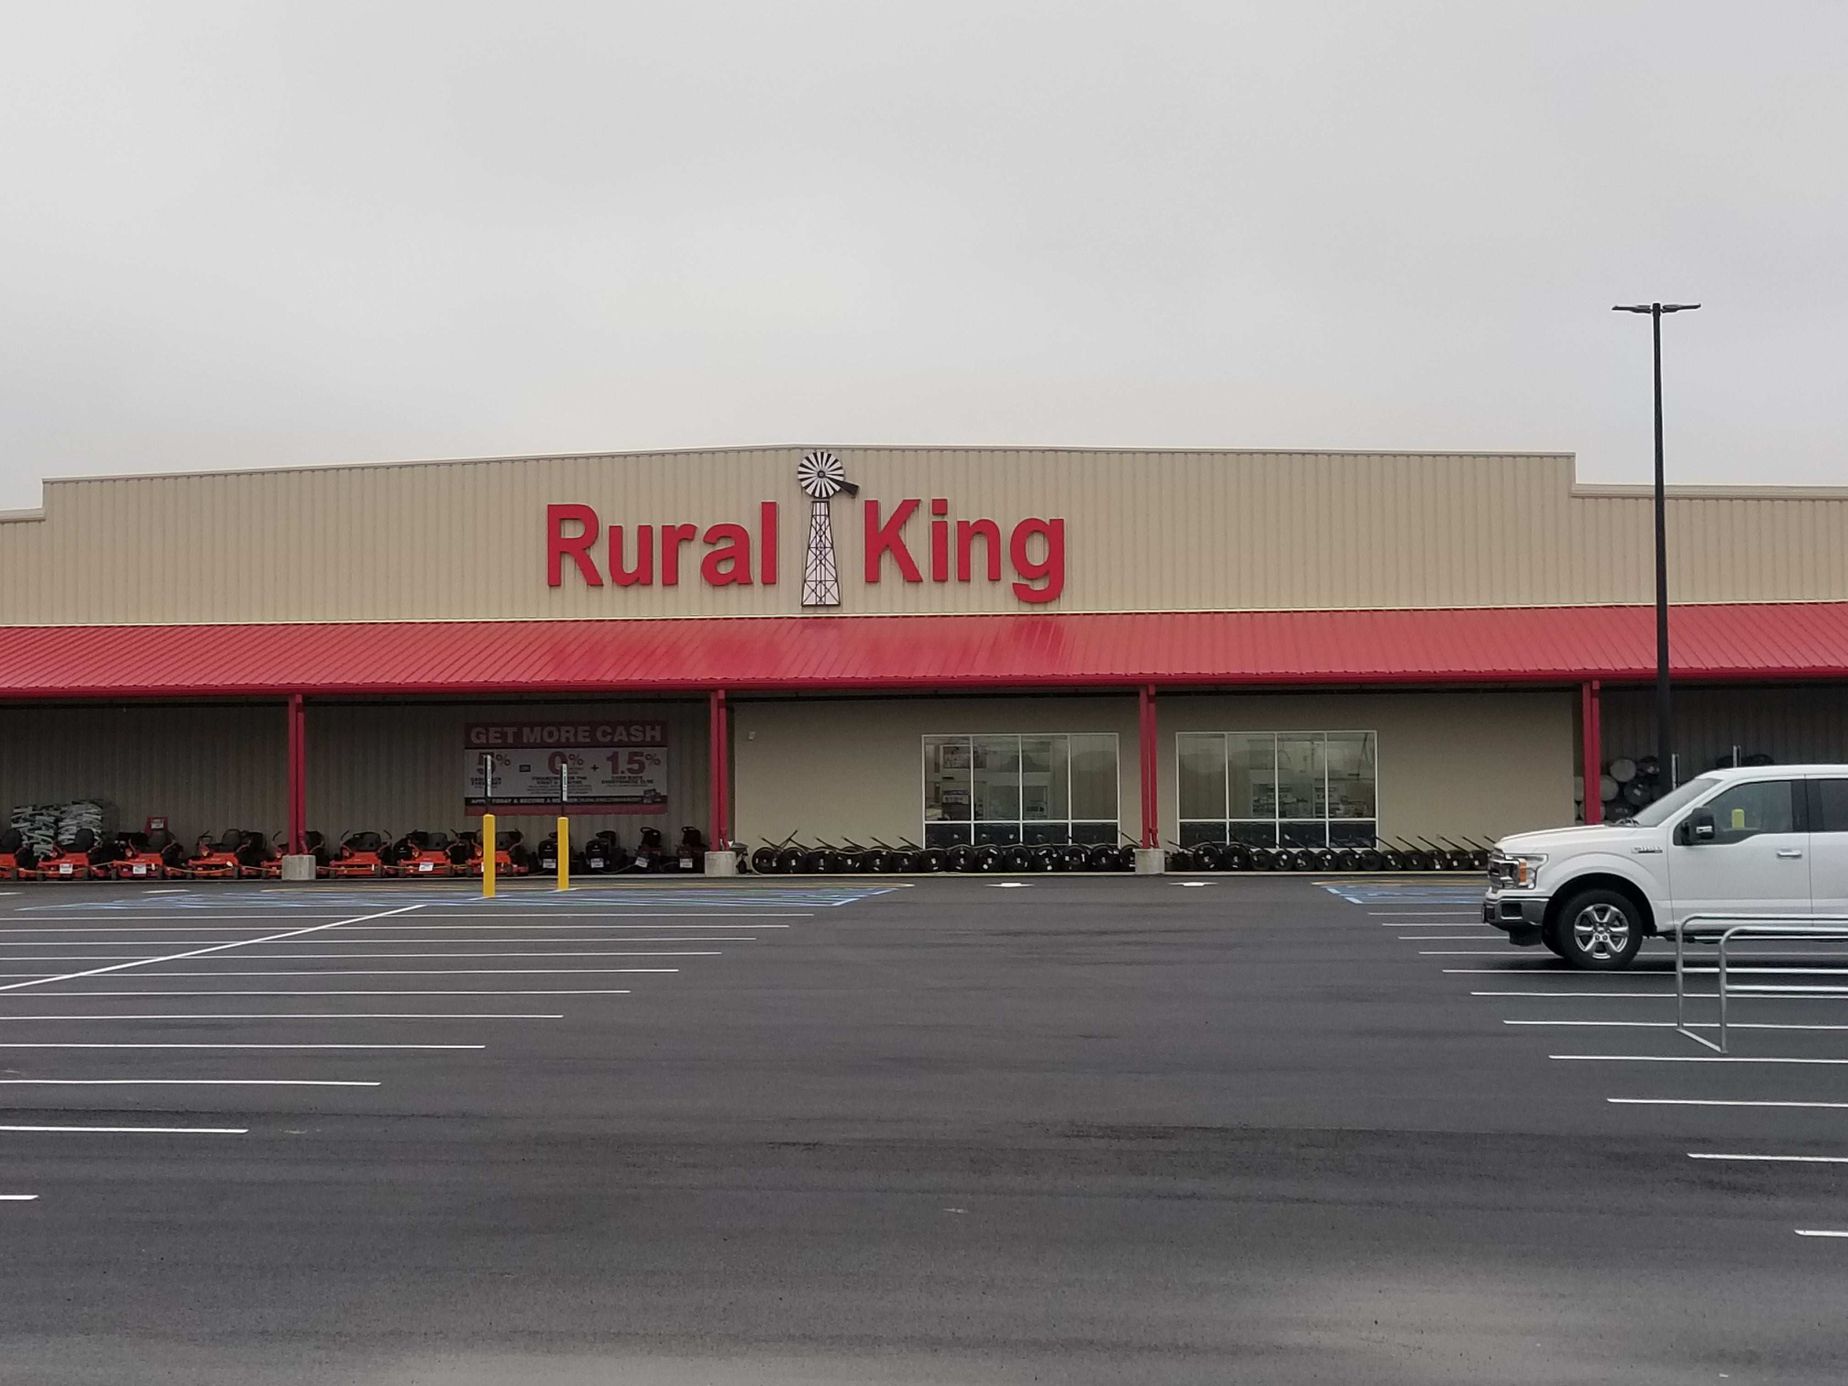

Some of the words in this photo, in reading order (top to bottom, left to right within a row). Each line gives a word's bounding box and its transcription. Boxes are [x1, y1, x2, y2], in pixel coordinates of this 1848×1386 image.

[547, 501, 777, 587] Rural
[864, 498, 1065, 604] King
[470, 726, 518, 744] GET
[522, 725, 591, 743] MORE
[596, 725, 662, 743] CASH
[606, 751, 661, 775] 1.5%
